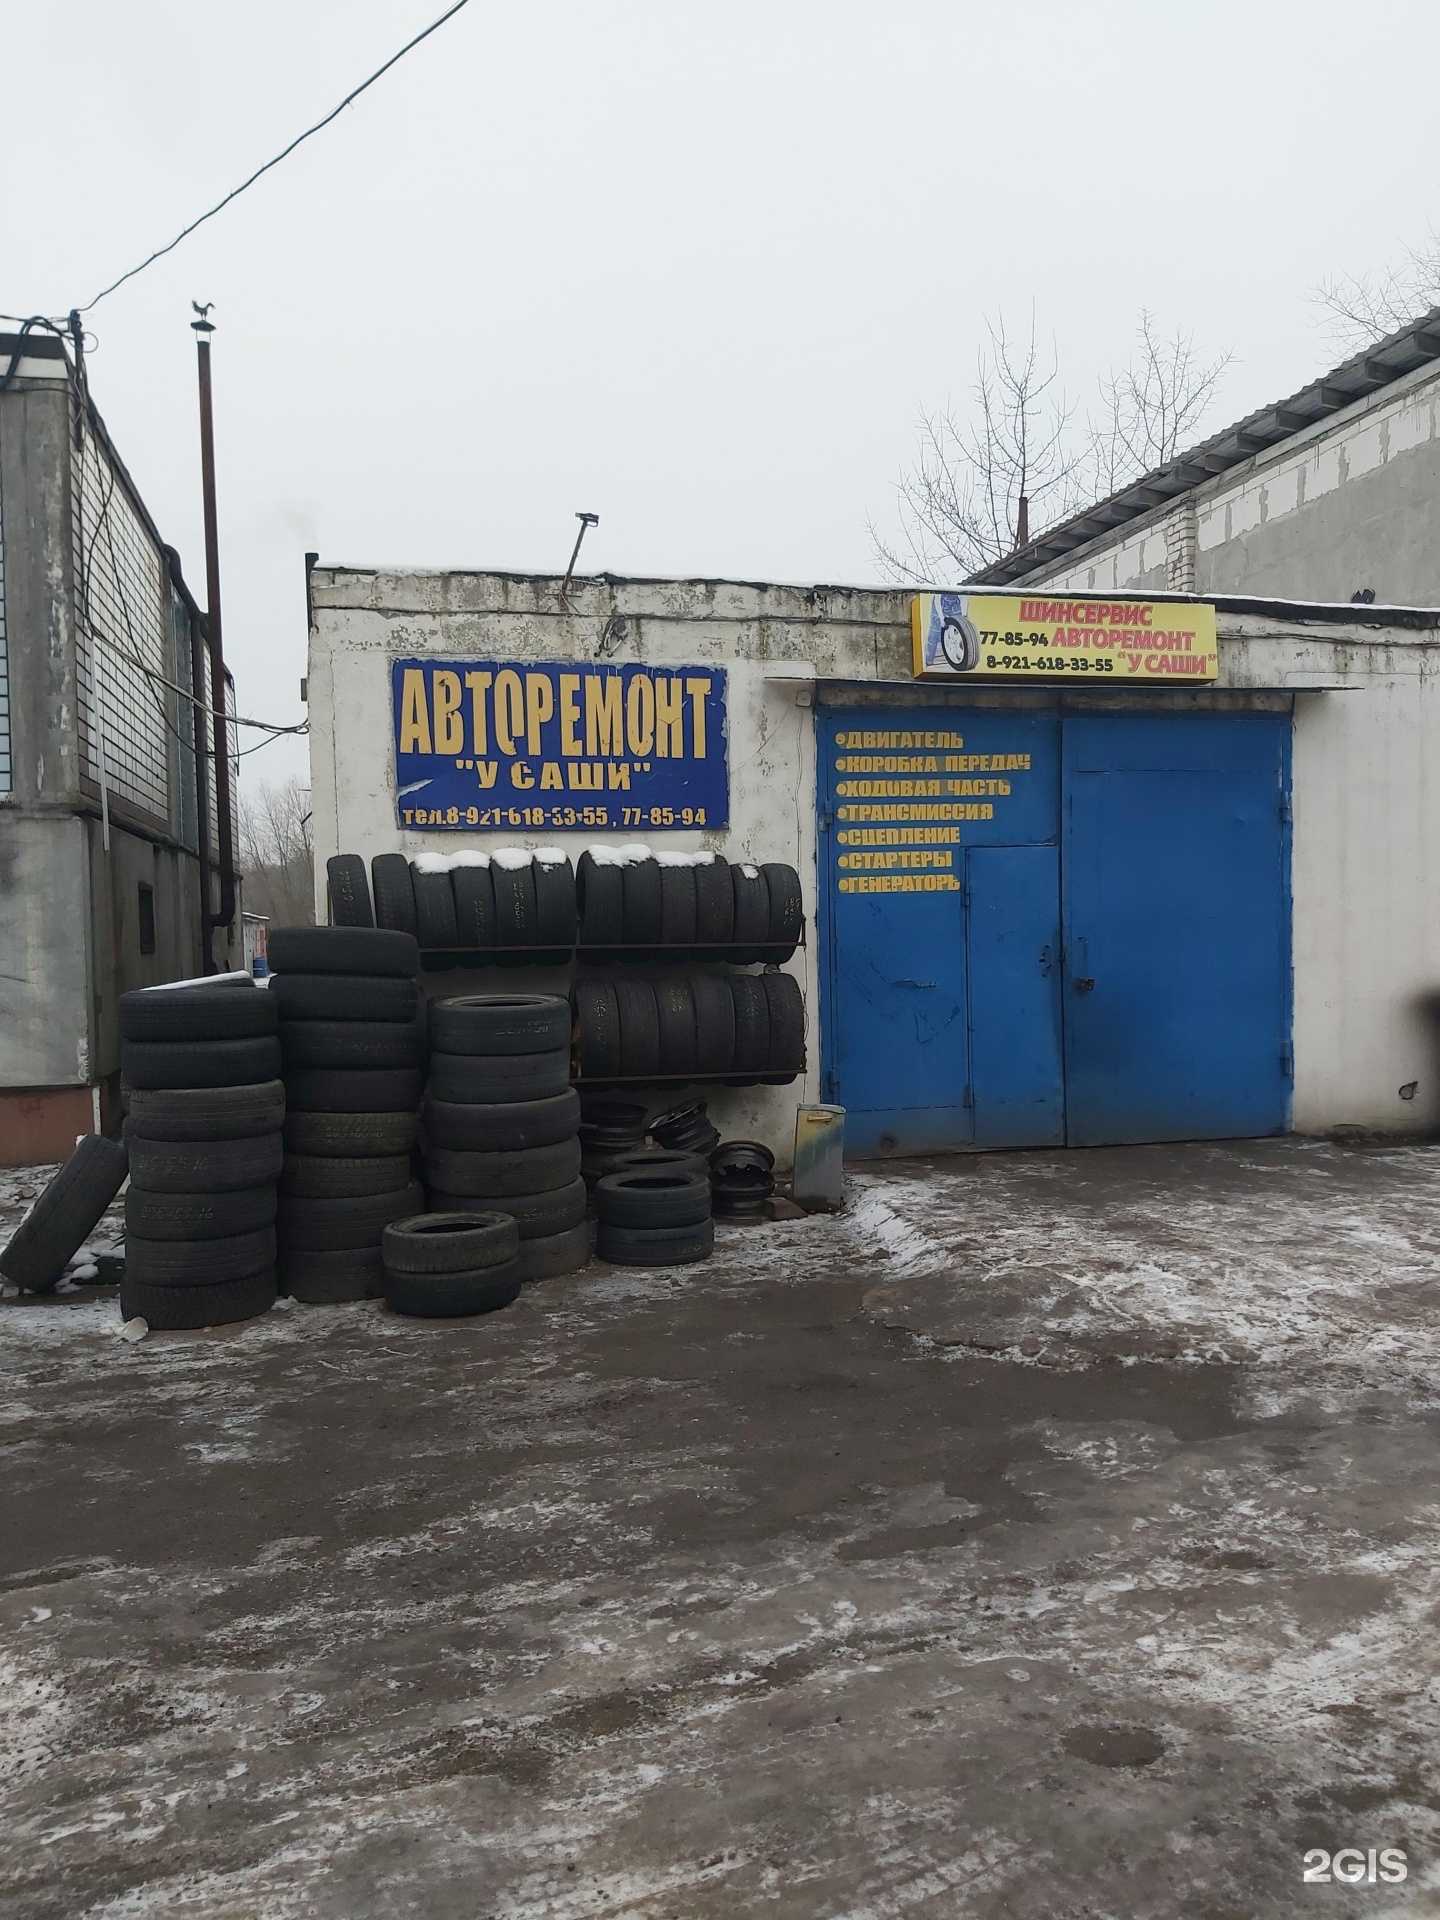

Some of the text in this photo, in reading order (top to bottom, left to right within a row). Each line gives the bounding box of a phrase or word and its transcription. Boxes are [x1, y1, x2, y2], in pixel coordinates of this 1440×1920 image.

[1018, 600, 1153, 626] ШИНСЕРВИС
[979, 627, 1197, 652] 77-85-94 АВТОРЕМОНТ
[986, 655, 1114, 672] 8-921-618-33-55
[399, 668, 712, 759] АВТОРЕМОНТ
[846, 731, 964, 749] ДВИГАТЕЛЬ
[846, 755, 938, 773] КОРОБКА
[456, 759, 651, 791] "У САШИ"
[846, 779, 1011, 797] ХОДОВАЯ ЧАСТЬ
[621, 806, 707, 826] 77-85-94
[847, 803, 994, 821] ТРАНСМИССИЯ
[847, 827, 961, 845] СЦЕПЛЕНИЕ
[848, 850, 953, 869] СТАРТЕРЫ
